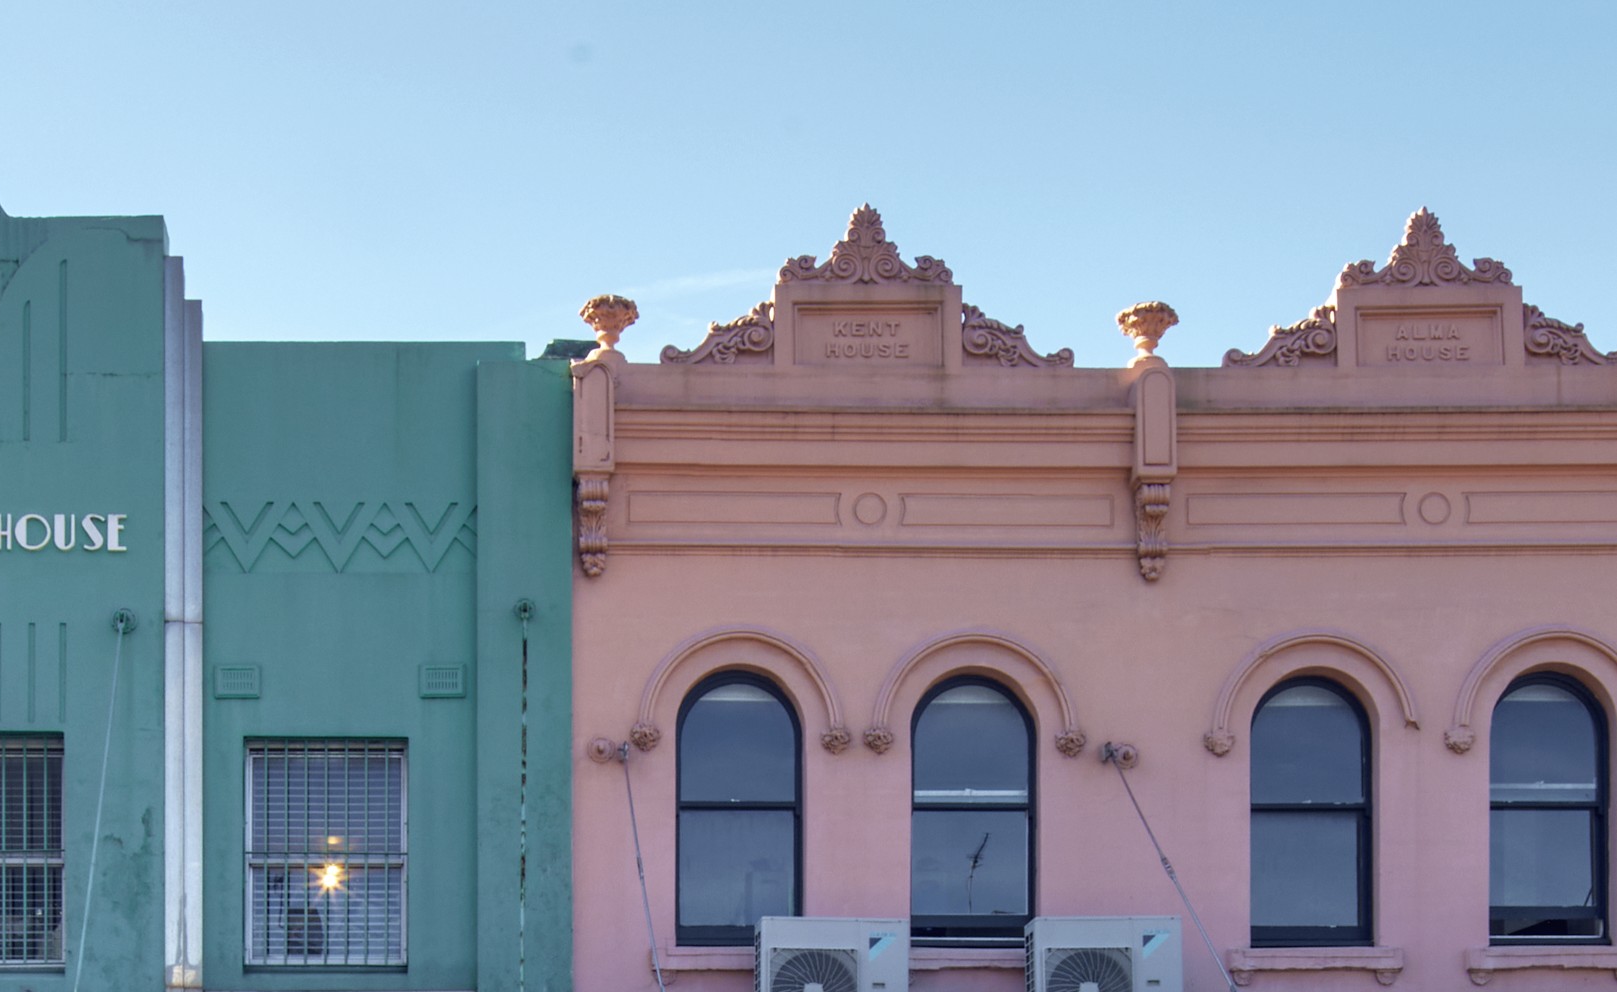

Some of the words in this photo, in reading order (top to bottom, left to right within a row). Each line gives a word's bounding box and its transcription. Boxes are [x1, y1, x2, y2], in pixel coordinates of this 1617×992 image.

[834, 320, 901, 337] KENT
[1395, 324, 1461, 341] ALMA
[825, 343, 910, 359] HOUSE
[1385, 346, 1471, 362] HOUSE
